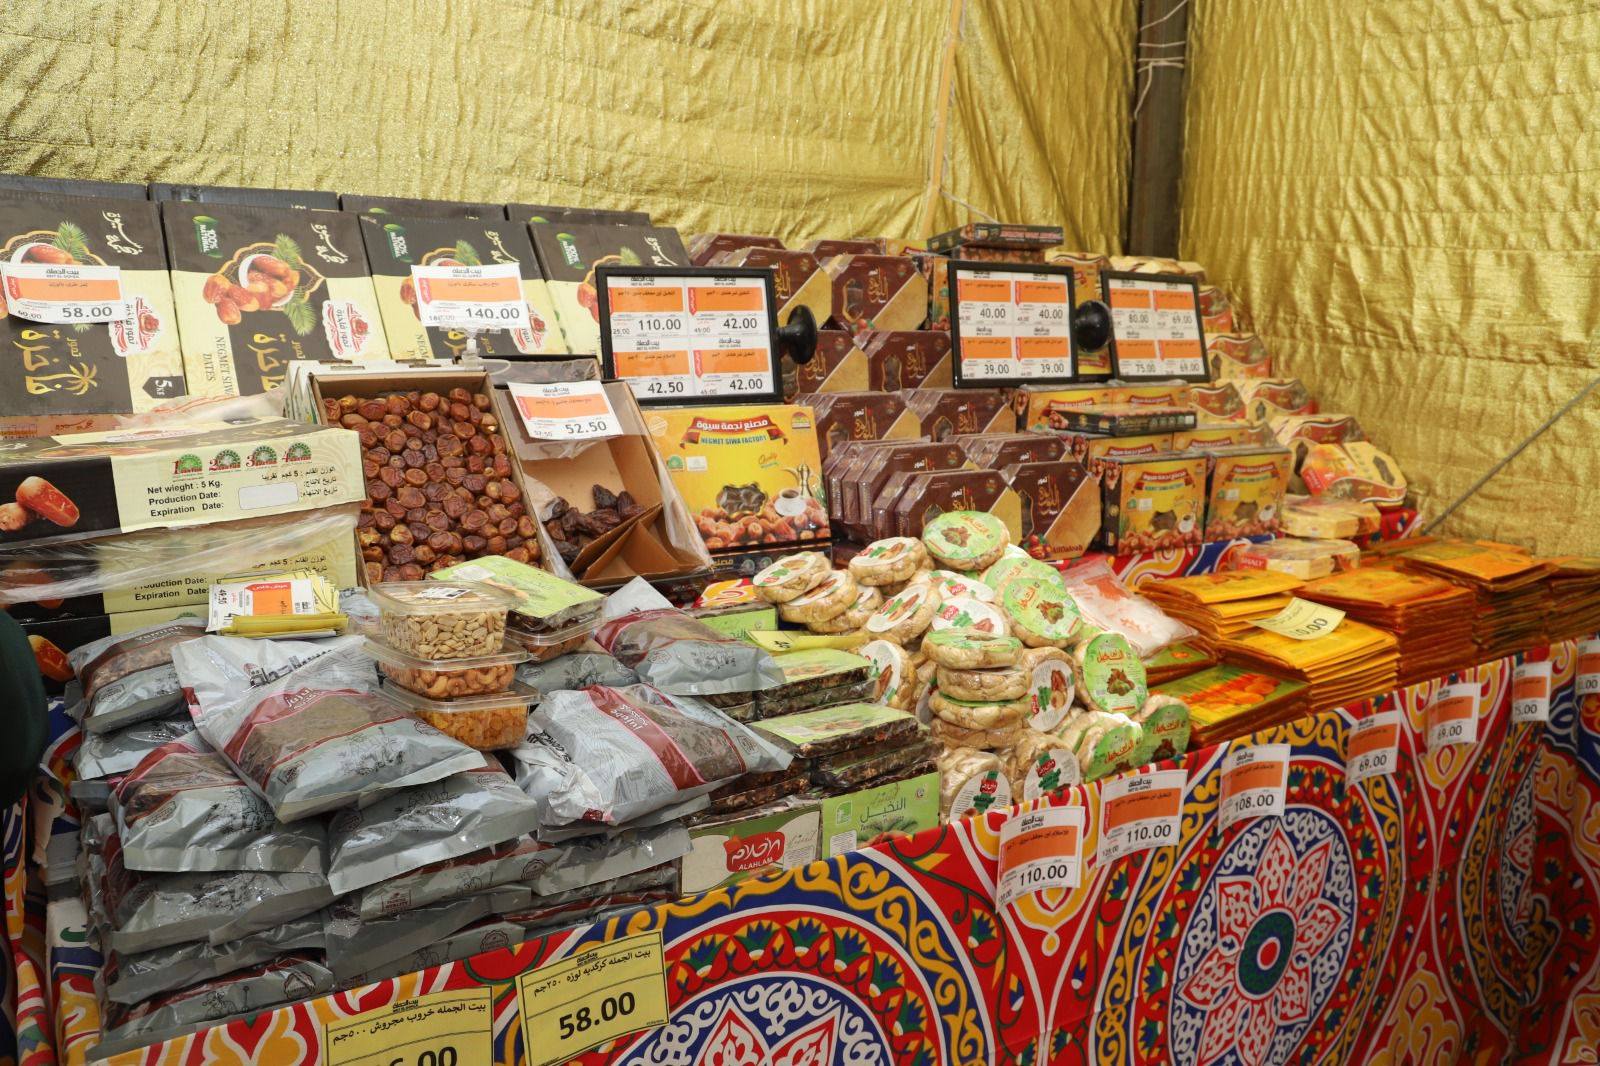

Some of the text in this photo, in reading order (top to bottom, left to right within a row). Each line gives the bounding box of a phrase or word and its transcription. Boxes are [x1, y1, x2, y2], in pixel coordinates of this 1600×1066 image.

[200, 224, 209, 252] NATURAL
[62, 306, 113, 318] 58.00
[465, 307, 520, 320] 140.00
[980, 308, 1006, 318] 40.00
[1039, 309, 1063, 319] 40.00
[638, 318, 681, 331] 110.00
[723, 318, 758, 329] 42.00
[215, 337, 228, 371] NEGMET
[203, 353, 215, 383] DATES
[984, 363, 1010, 375] 39.00
[1040, 363, 1065, 374] 39.00
[647, 381, 684, 394] 42.50
[729, 378, 763, 390] 42.00
[565, 420, 607, 434] 52.50
[697, 419, 768, 431] مصنع نجمة سيوة
[701, 437, 724, 445] NEGMET
[742, 435, 768, 444] FACTORY
[147, 486, 162, 494] Net
[164, 483, 194, 493] wieght
[208, 480, 223, 488] Kg.
[322, 477, 337, 486] تاريخ
[149, 491, 221, 505] Production Date:
[323, 488, 338, 497] تاريخ
[150, 503, 224, 517] Expiration Date:
[185, 577, 208, 586] Date:
[135, 590, 180, 602] Expiration
[1359, 753, 1388, 773] 69.00
[1235, 794, 1274, 812] 108.00
[1127, 824, 1172, 844] 110.00
[738, 857, 774, 871] ALAHLAM
[1019, 864, 1068, 886] 110.00
[608, 953, 633, 966] الجمله
[634, 950, 651, 961] بيت
[583, 960, 607, 975] كركديه
[566, 969, 581, 983] لوزه
[437, 1004, 466, 1015] الجمله
[468, 1002, 486, 1012] بيت
[406, 1010, 435, 1024] خروب
[559, 991, 637, 1040] 58.00
[370, 1016, 404, 1034] مجروش
